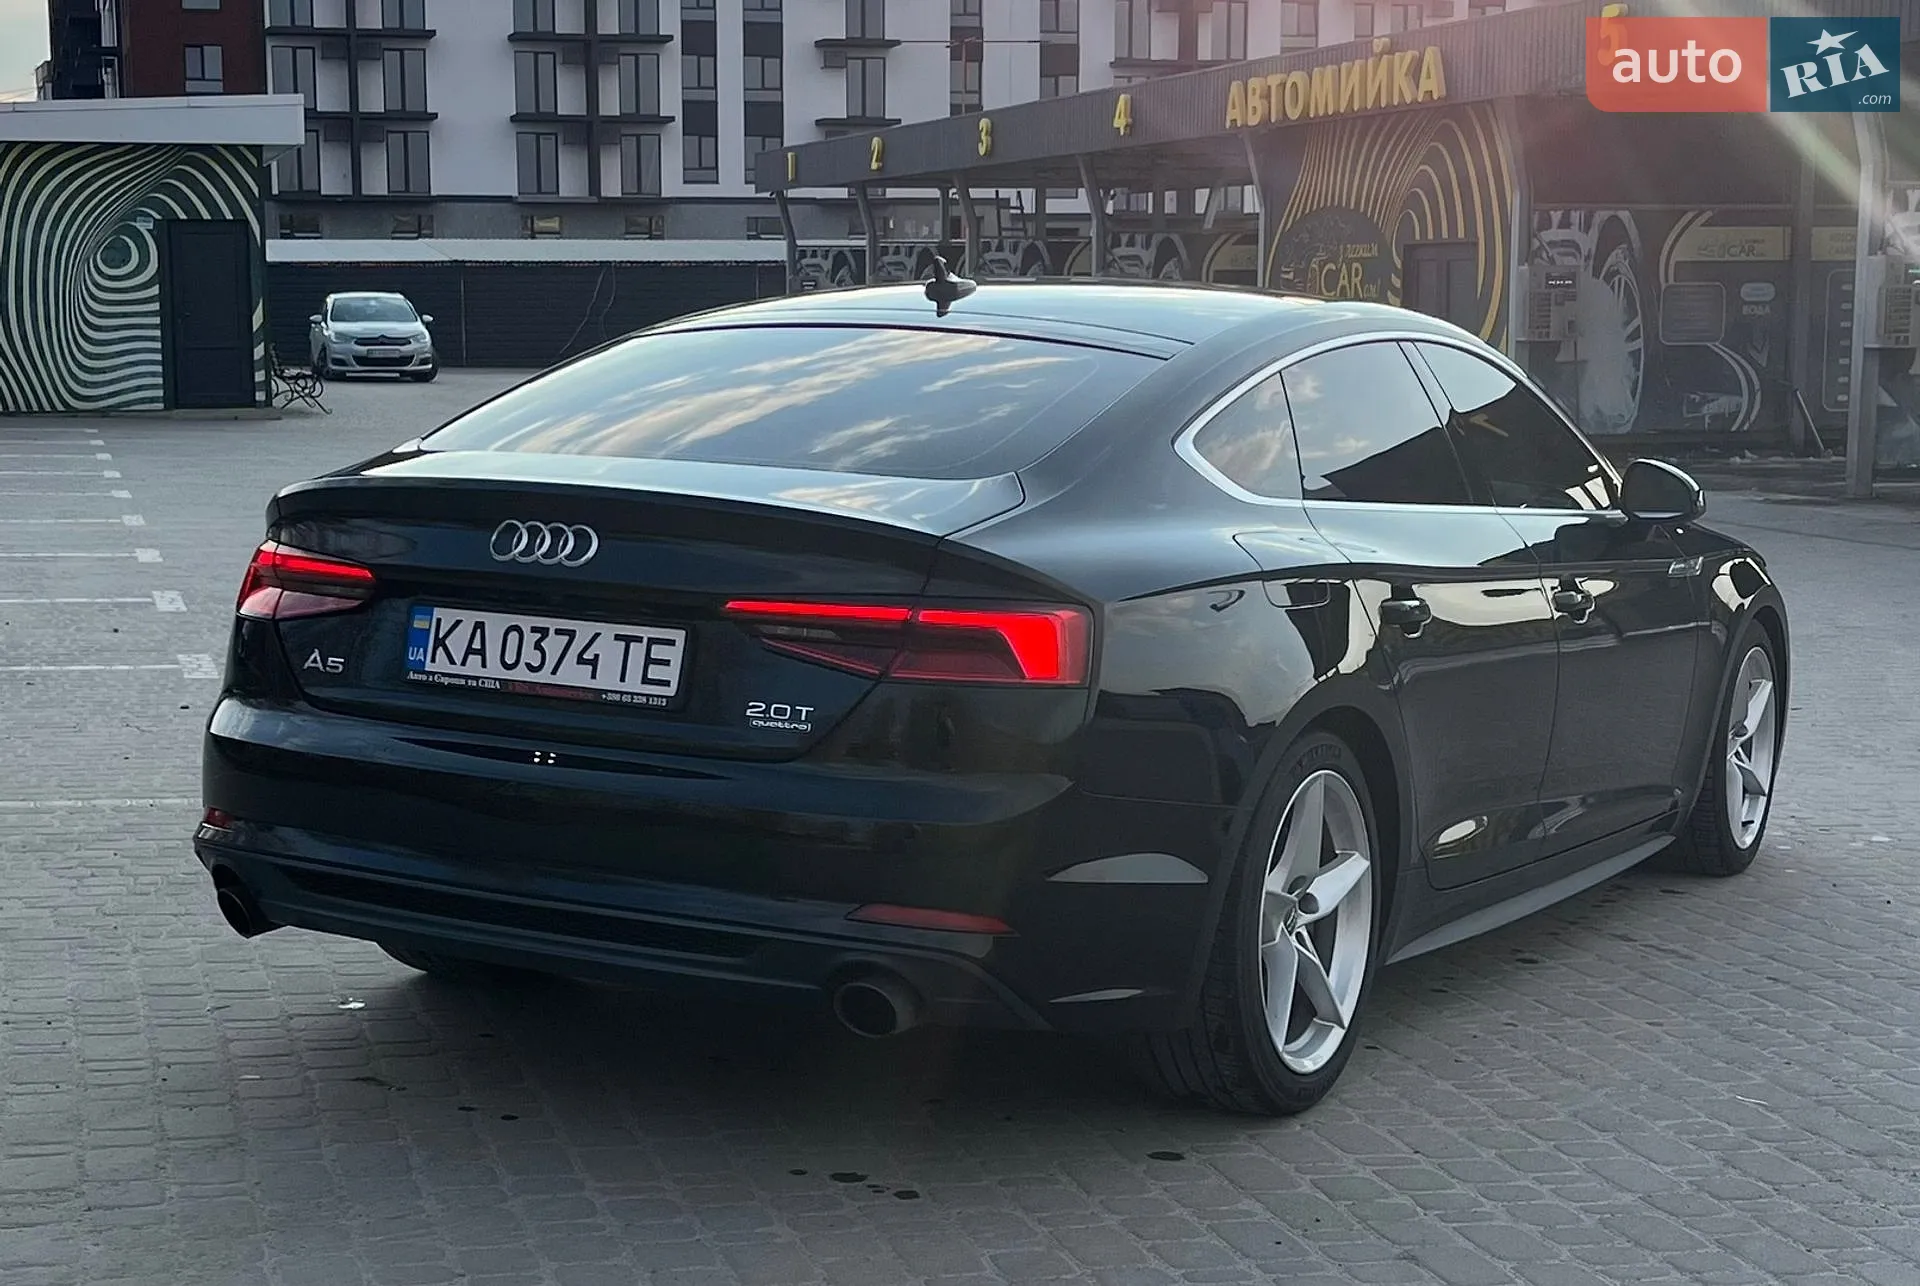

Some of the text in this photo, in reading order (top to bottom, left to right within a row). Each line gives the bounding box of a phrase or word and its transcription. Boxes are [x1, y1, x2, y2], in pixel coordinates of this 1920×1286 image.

[1226, 37, 1446, 128] АВТОМИЙКА
[1113, 93, 1133, 137] 4
[870, 136, 884, 171] 2
[977, 118, 992, 157] 3
[786, 152, 796, 182] 1
[303, 648, 345, 673] A5
[408, 648, 425, 662] UA
[430, 617, 677, 688] KA 0374 TE
[752, 720, 808, 730] quattro
